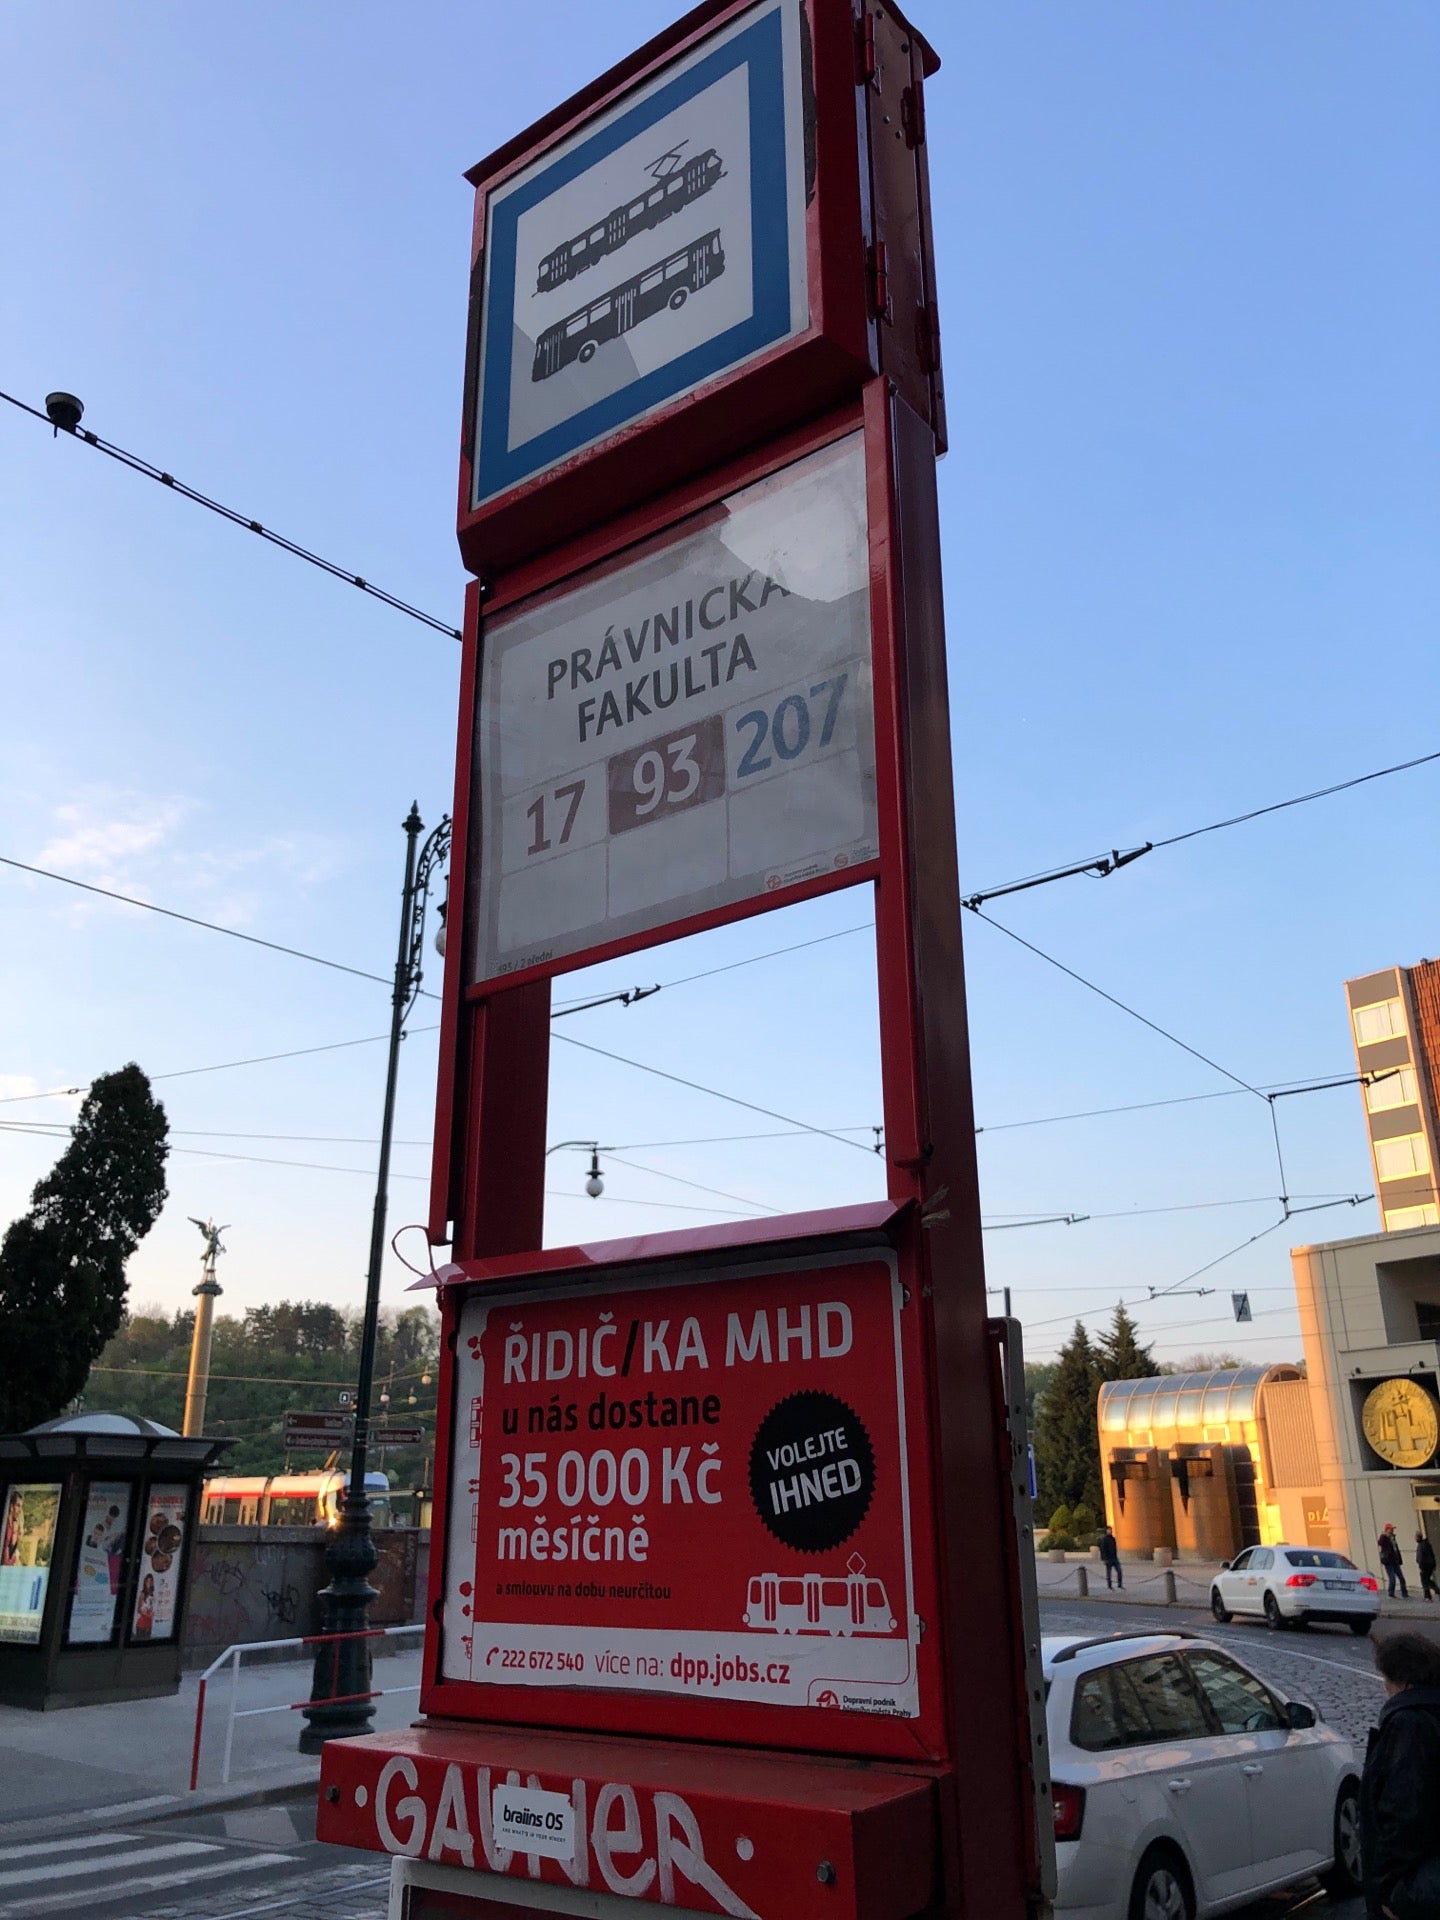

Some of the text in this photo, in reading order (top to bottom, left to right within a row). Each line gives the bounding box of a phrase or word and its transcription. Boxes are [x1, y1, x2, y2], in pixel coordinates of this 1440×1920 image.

[578, 632, 758, 742] FAKULTA
[527, 673, 849, 856] 17 93 207
[503, 1301, 854, 1384] ŘIDIČ/KA MHD
[502, 1391, 722, 1435] u nás dostane
[767, 1427, 848, 1471] VOLEJTE
[498, 1441, 723, 1508] 35 000 Kč
[769, 1458, 862, 1515] IHNED
[497, 1514, 649, 1562] měsíčně
[495, 1579, 671, 1600] a smlouvu na dobu neurčitou
[501, 1649, 791, 1687] 222 672 540 více na: dpp.jobs.cz
[842, 1695, 897, 1707] Dopravní podnik
[503, 1804, 564, 1830] braiins OS
